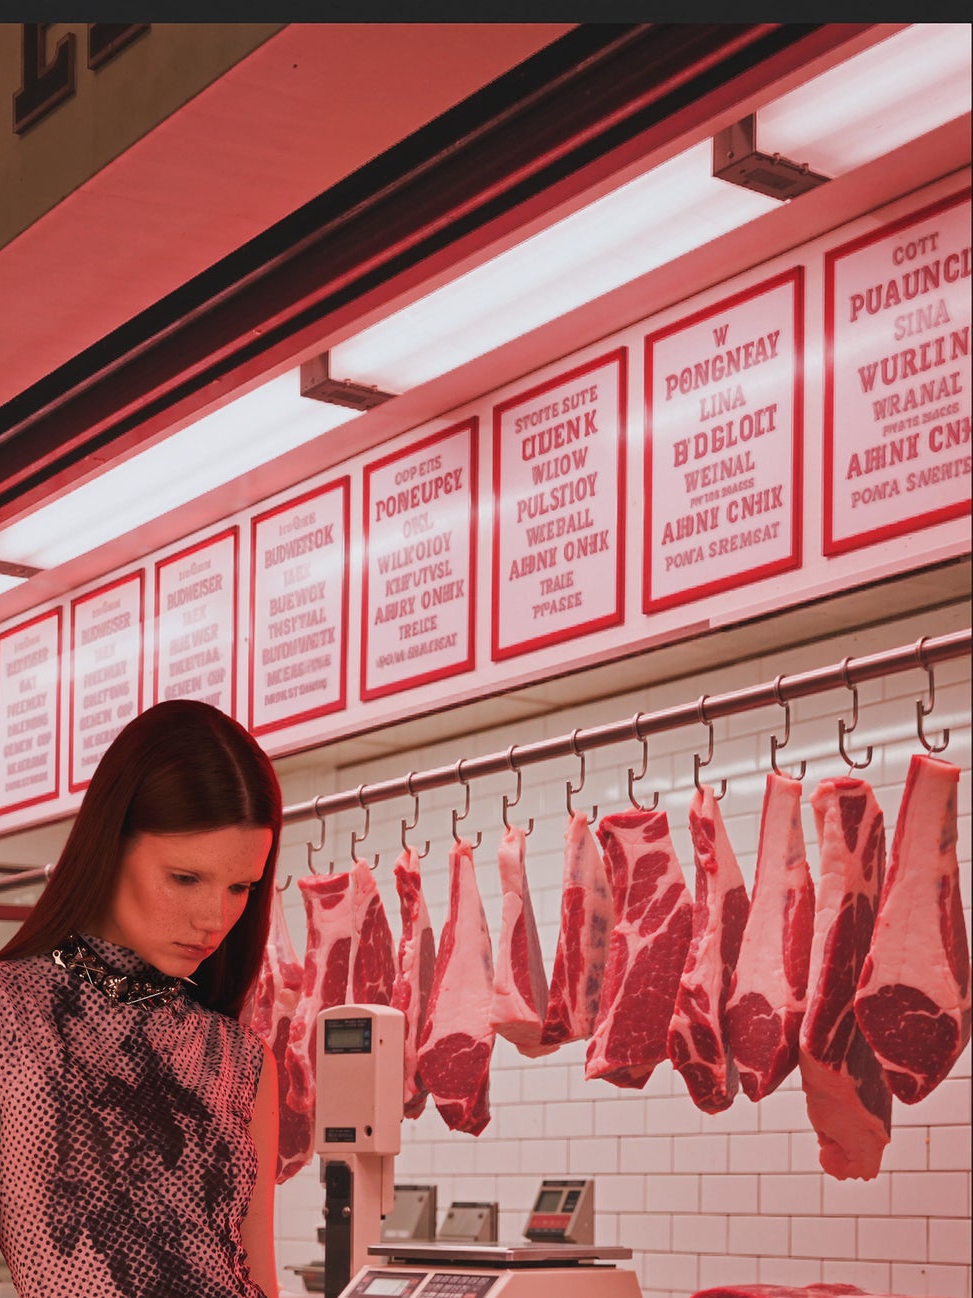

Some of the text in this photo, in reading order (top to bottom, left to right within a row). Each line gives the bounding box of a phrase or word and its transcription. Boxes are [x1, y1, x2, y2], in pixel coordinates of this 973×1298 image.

[894, 299, 950, 341] SINA
[700, 384, 747, 422] LINA
[684, 451, 756, 493] WEINAL
